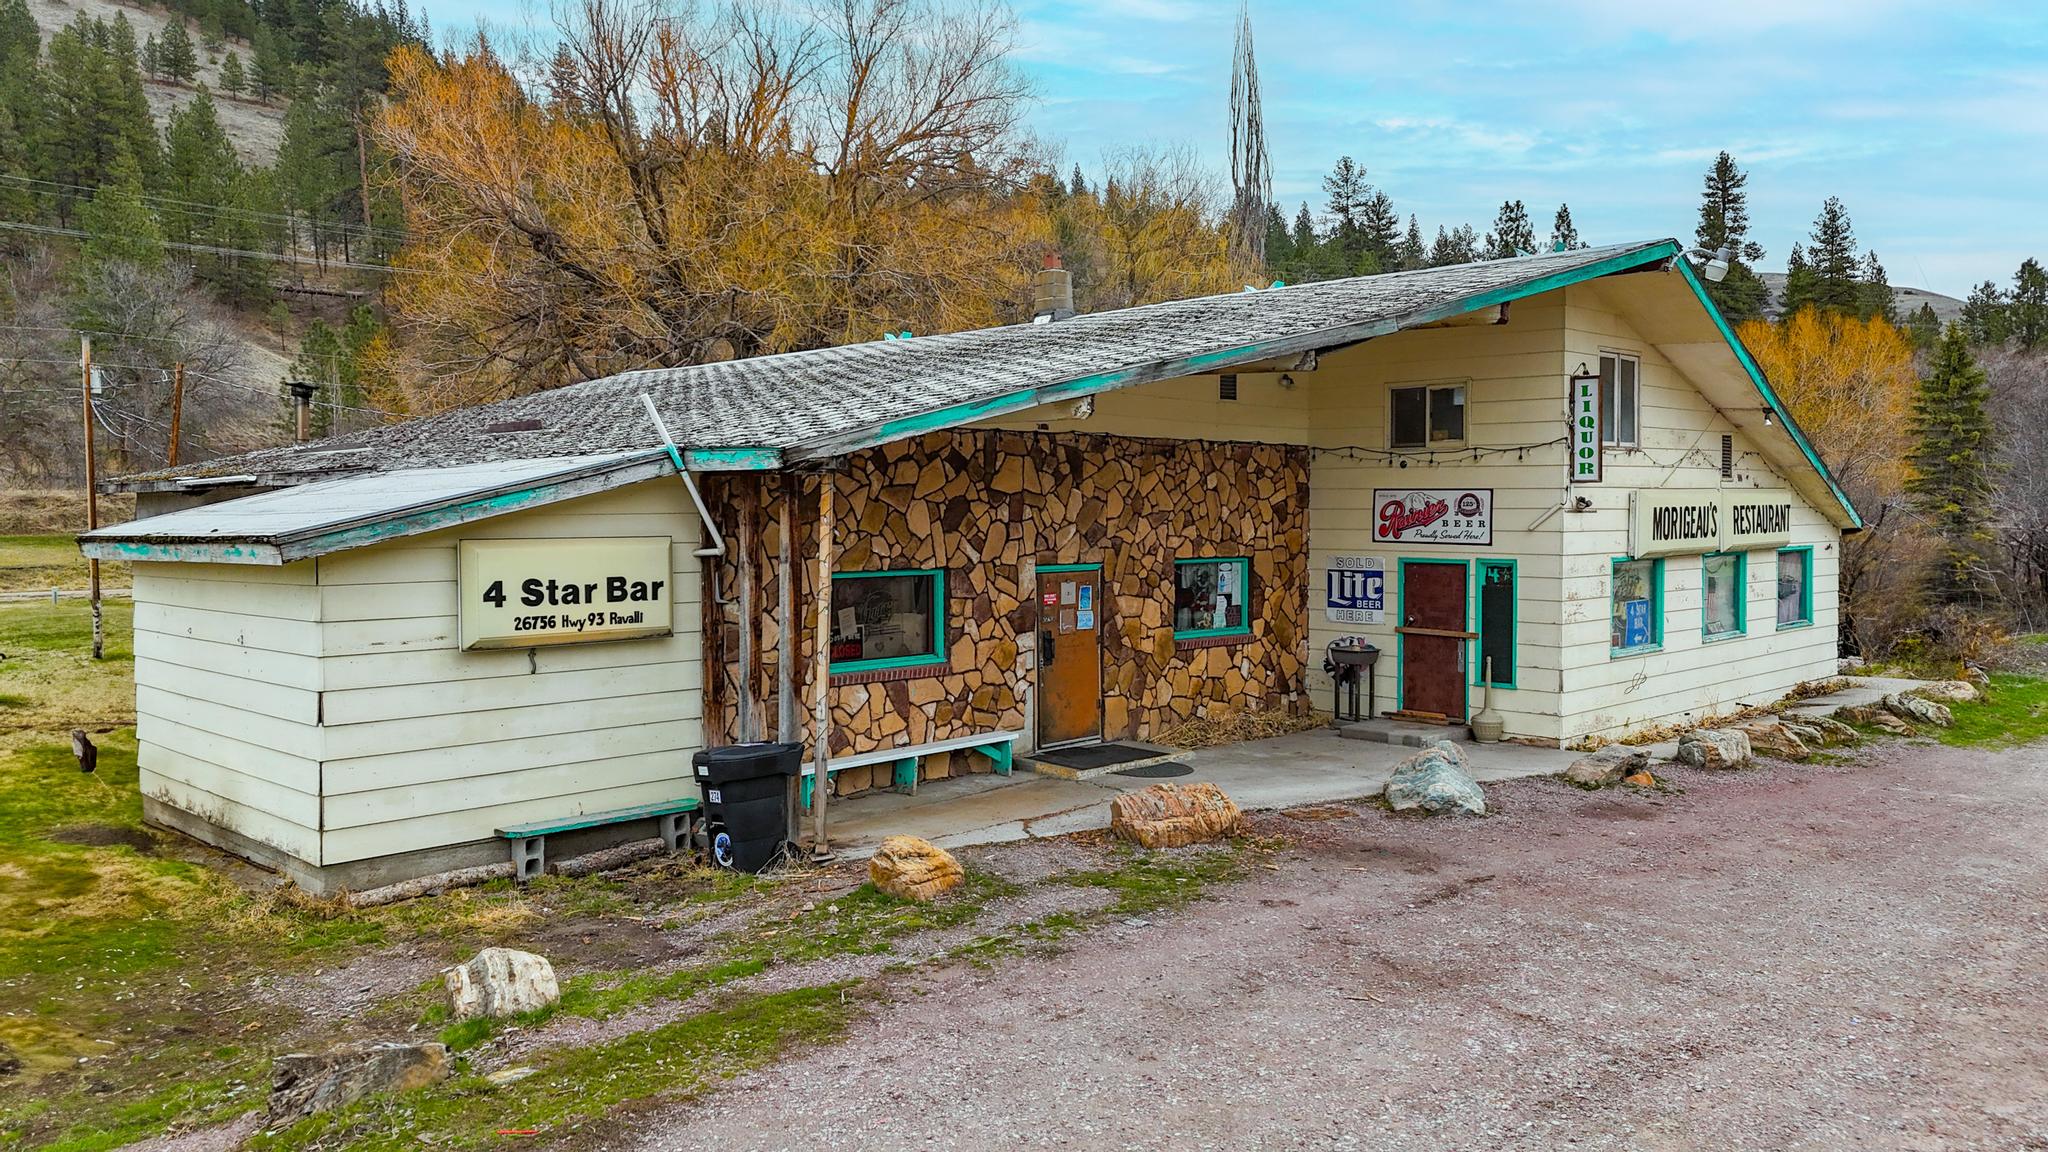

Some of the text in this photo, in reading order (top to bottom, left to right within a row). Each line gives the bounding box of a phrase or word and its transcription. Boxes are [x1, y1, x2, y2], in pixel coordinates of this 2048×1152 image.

[1578, 384, 1595, 475] LIQUOR
[1378, 498, 1449, 540] Rainier
[1441, 519, 1486, 528] BEER
[1653, 502, 1791, 541] MORIGEAU'S RESTAURANT
[1414, 528, 1485, 541] Proudly Served Here!
[1336, 557, 1375, 568] SOLD
[482, 576, 664, 608] 4 Star Bar
[1328, 570, 1383, 606] Lite
[1356, 599, 1381, 609] BEER
[514, 611, 644, 632] 26756 Hwy 93 Ravalli
[1336, 610, 1374, 622] HERE
